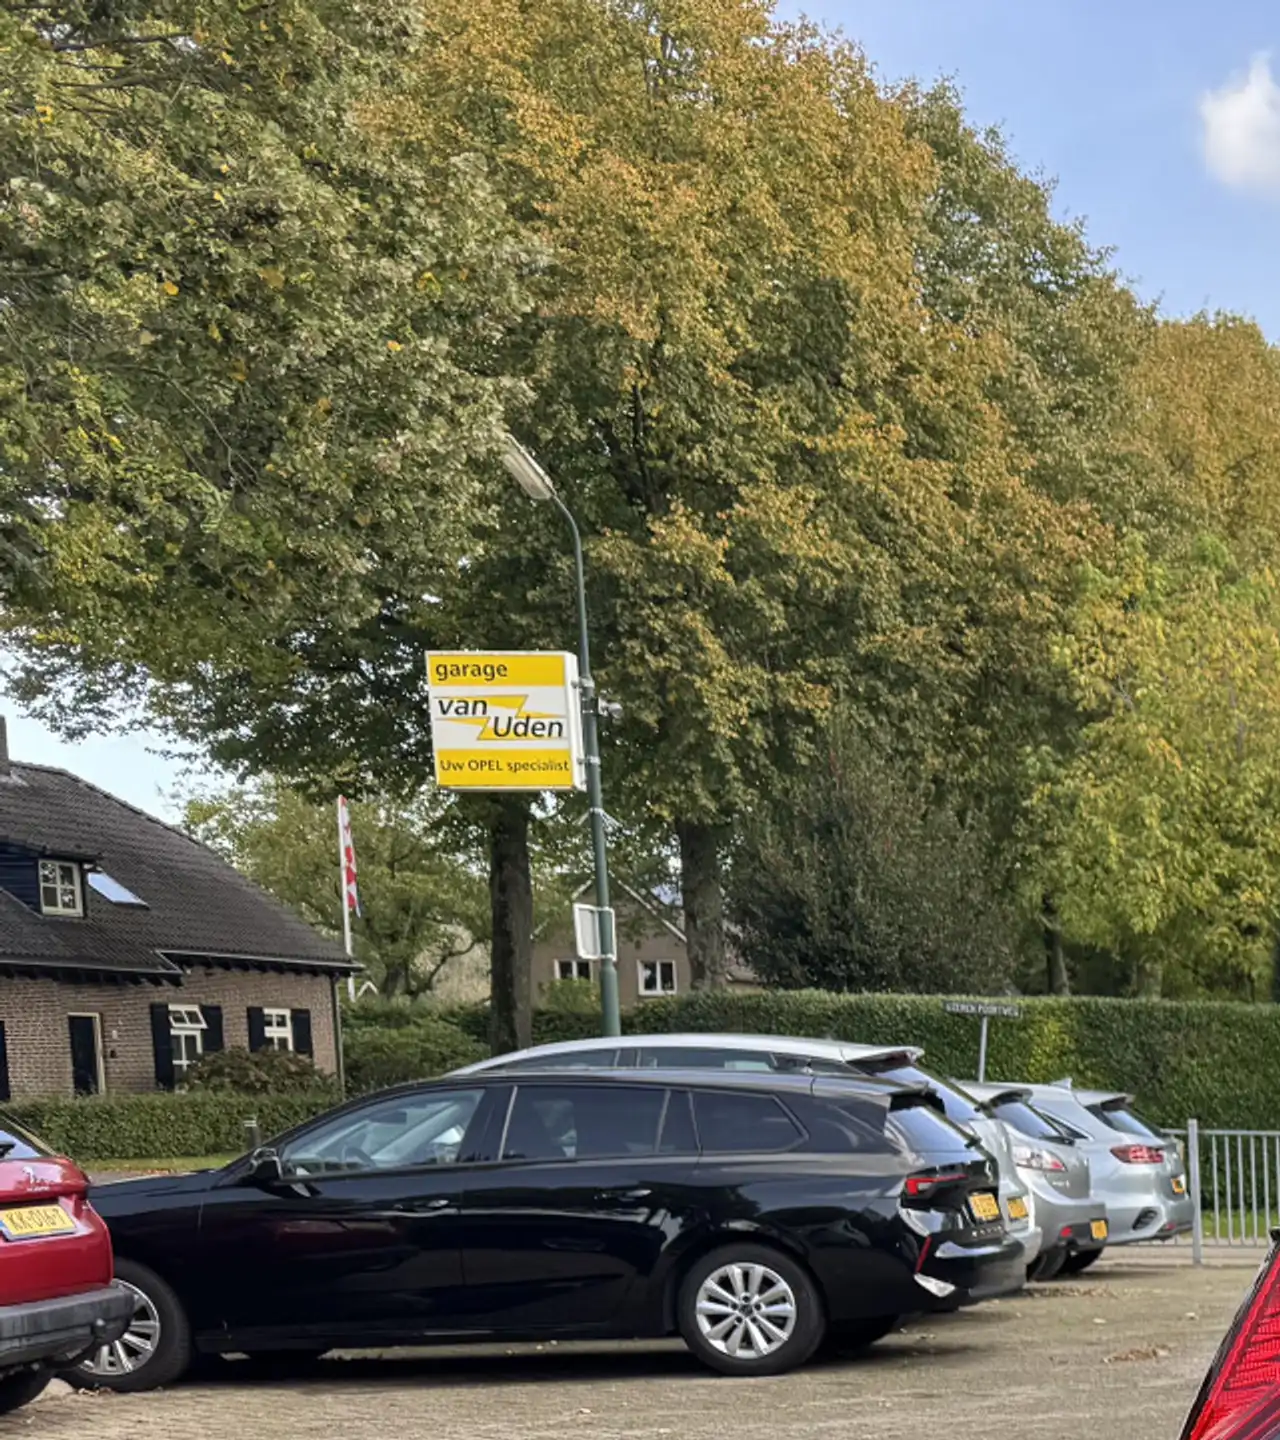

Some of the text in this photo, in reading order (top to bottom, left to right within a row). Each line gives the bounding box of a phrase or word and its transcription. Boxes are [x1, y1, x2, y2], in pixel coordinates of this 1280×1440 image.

[435, 663, 508, 681] garage
[438, 698, 488, 716] van
[493, 715, 563, 738] Uden
[440, 758, 570, 774] Uw OPEL specialist
